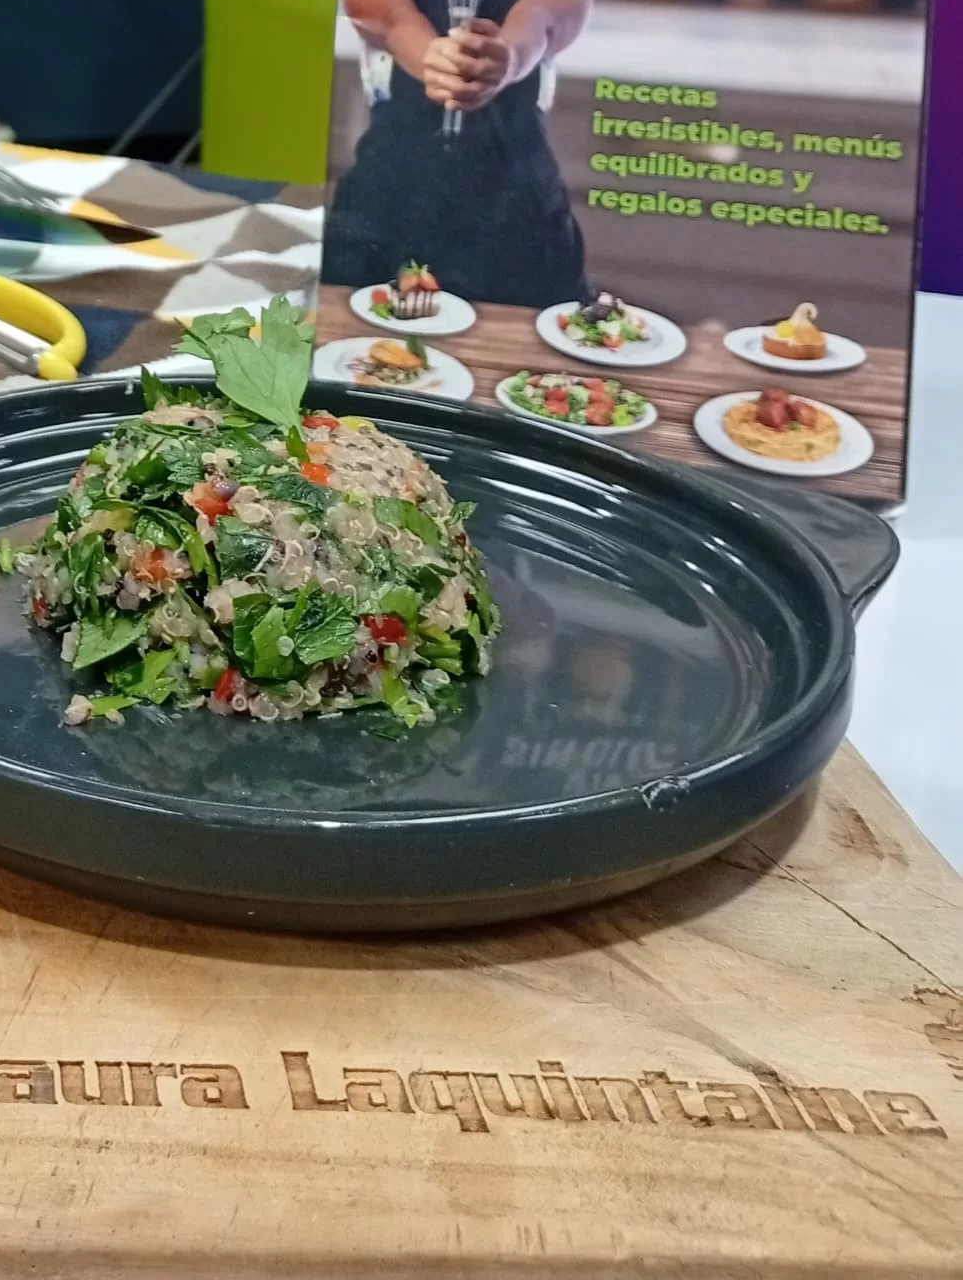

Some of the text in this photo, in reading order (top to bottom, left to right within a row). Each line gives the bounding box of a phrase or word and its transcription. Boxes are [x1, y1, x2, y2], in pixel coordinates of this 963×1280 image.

[594, 78, 718, 108] Recetas
[592, 110, 903, 160] irresistibles, menús
[589, 151, 814, 193] equilibrados y
[587, 187, 889, 234] regalos especiales.
[280, 1051, 948, 1139] Laquintaine
